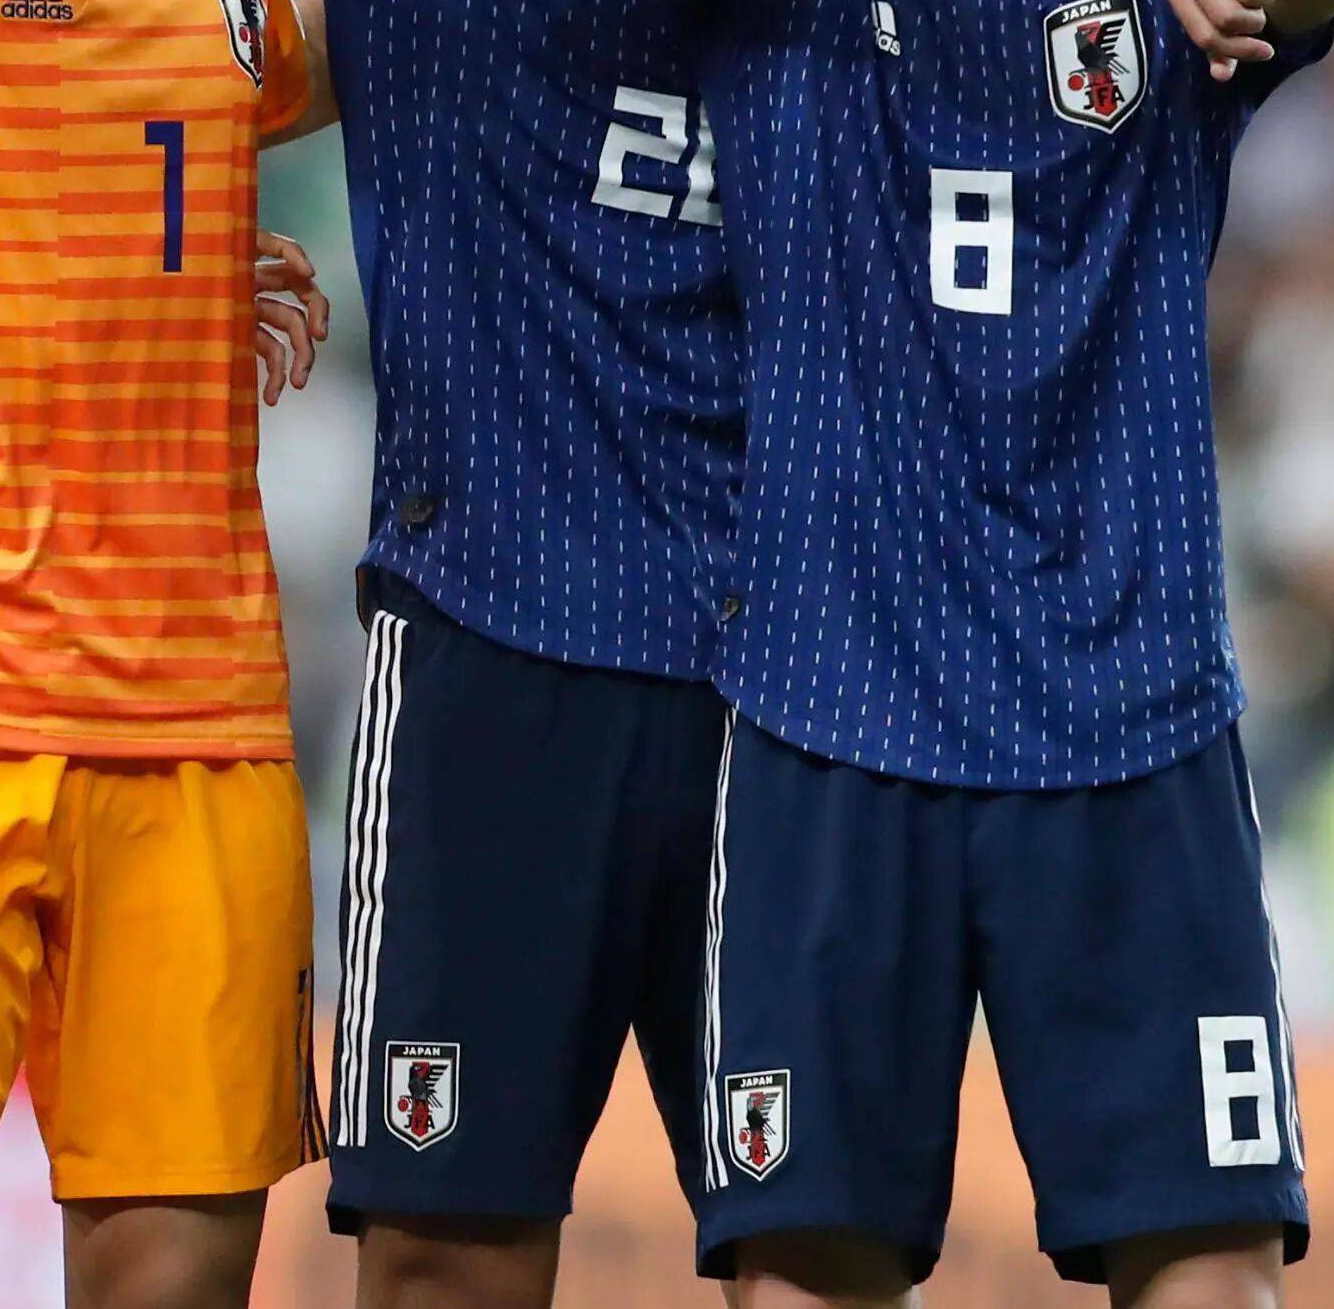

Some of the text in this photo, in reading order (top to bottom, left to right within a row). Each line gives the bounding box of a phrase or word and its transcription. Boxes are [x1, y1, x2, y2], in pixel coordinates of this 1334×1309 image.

[1, 0, 74, 21] adidas
[1061, 0, 1112, 24] JAPAN
[145, 121, 183, 272] 1
[931, 169, 1013, 315] 8
[403, 1047, 440, 1057] JAPAN
[740, 1076, 773, 1089] JAPAN
[1198, 1016, 1280, 1166] 8
